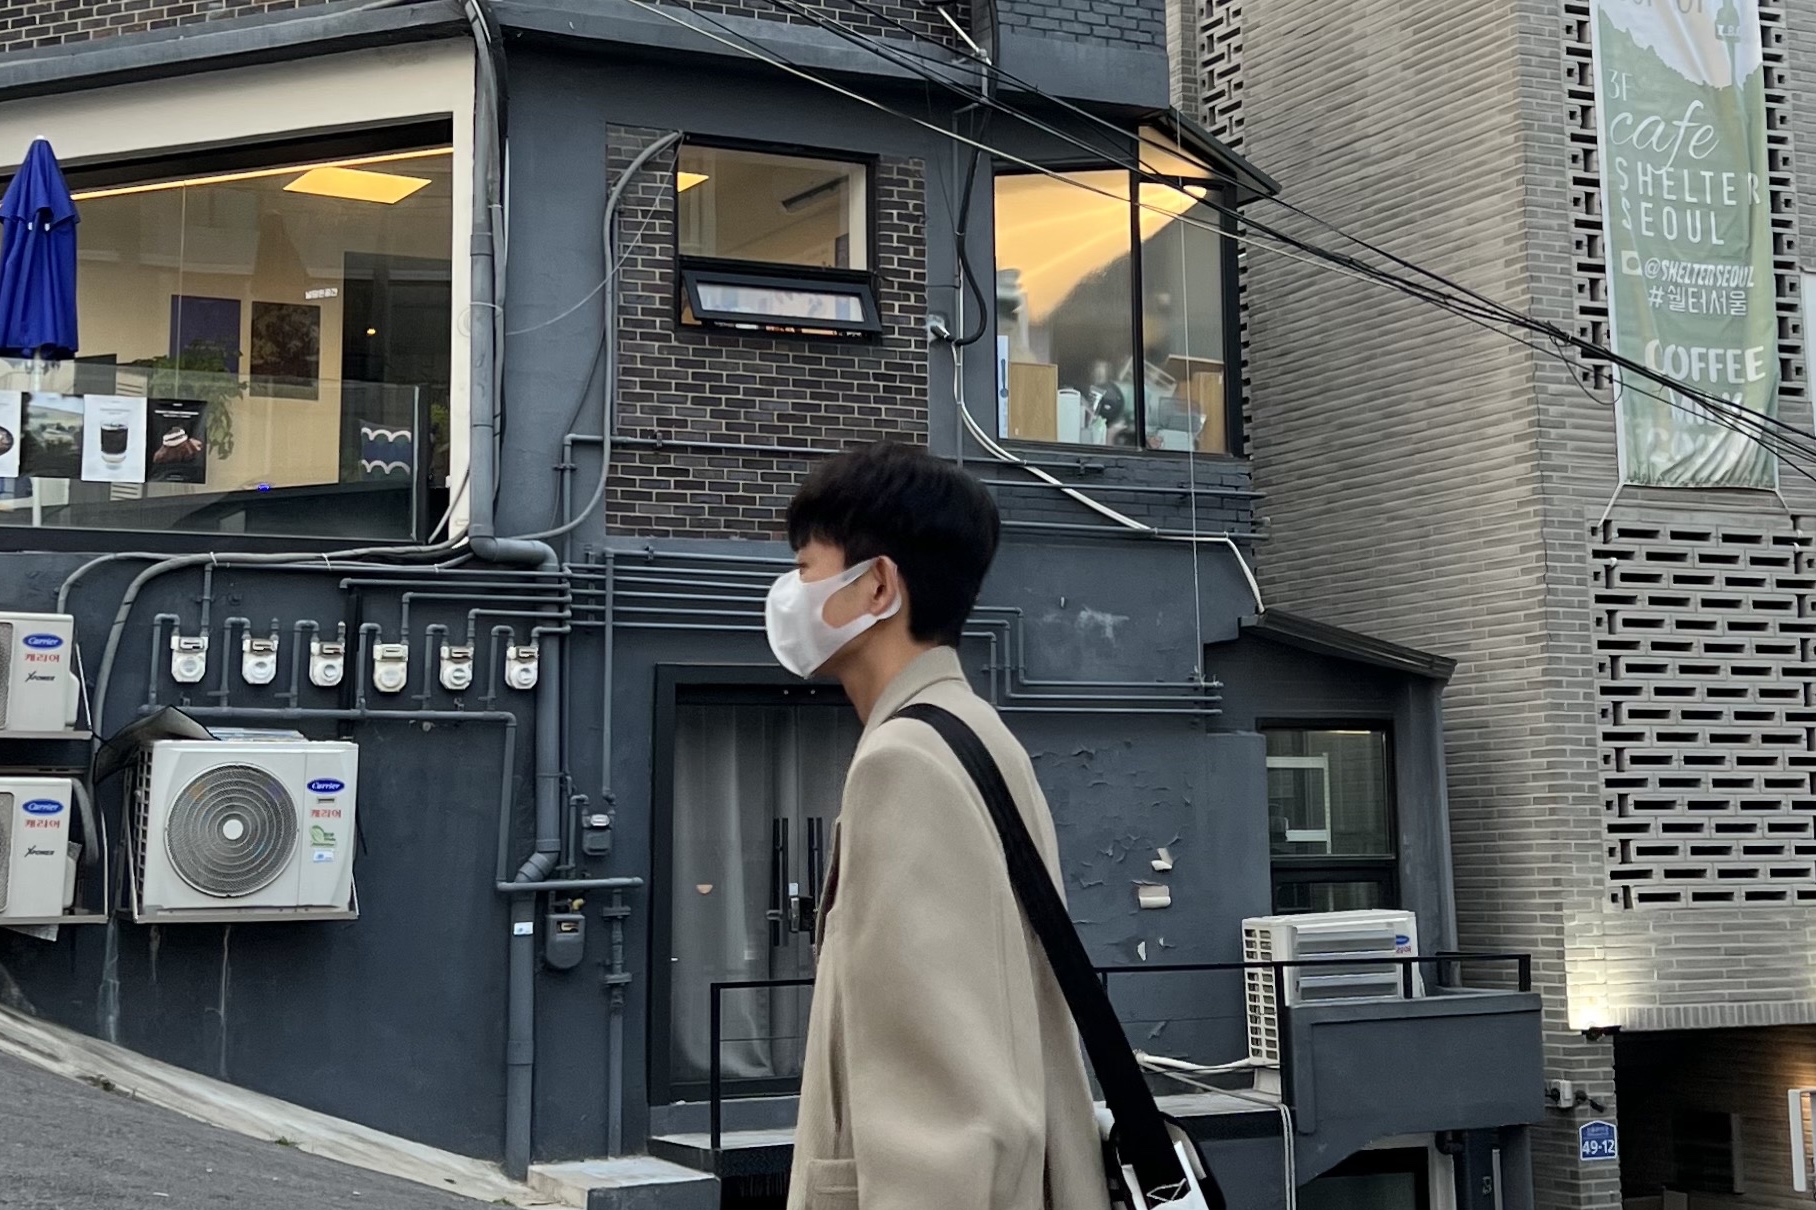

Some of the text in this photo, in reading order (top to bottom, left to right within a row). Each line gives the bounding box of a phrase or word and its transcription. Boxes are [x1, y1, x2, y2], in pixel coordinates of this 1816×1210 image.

[1607, 68, 1633, 101] 3F
[1610, 99, 1720, 175] cafe
[1615, 156, 1761, 206] SHELTER
[1621, 197, 1725, 246] SEOUL
[1648, 284, 1748, 317] #쉘터서울
[1644, 338, 1767, 385] COFFEE
[311, 781, 341, 791] Carrier
[1582, 1139, 1616, 1155] 49-12
